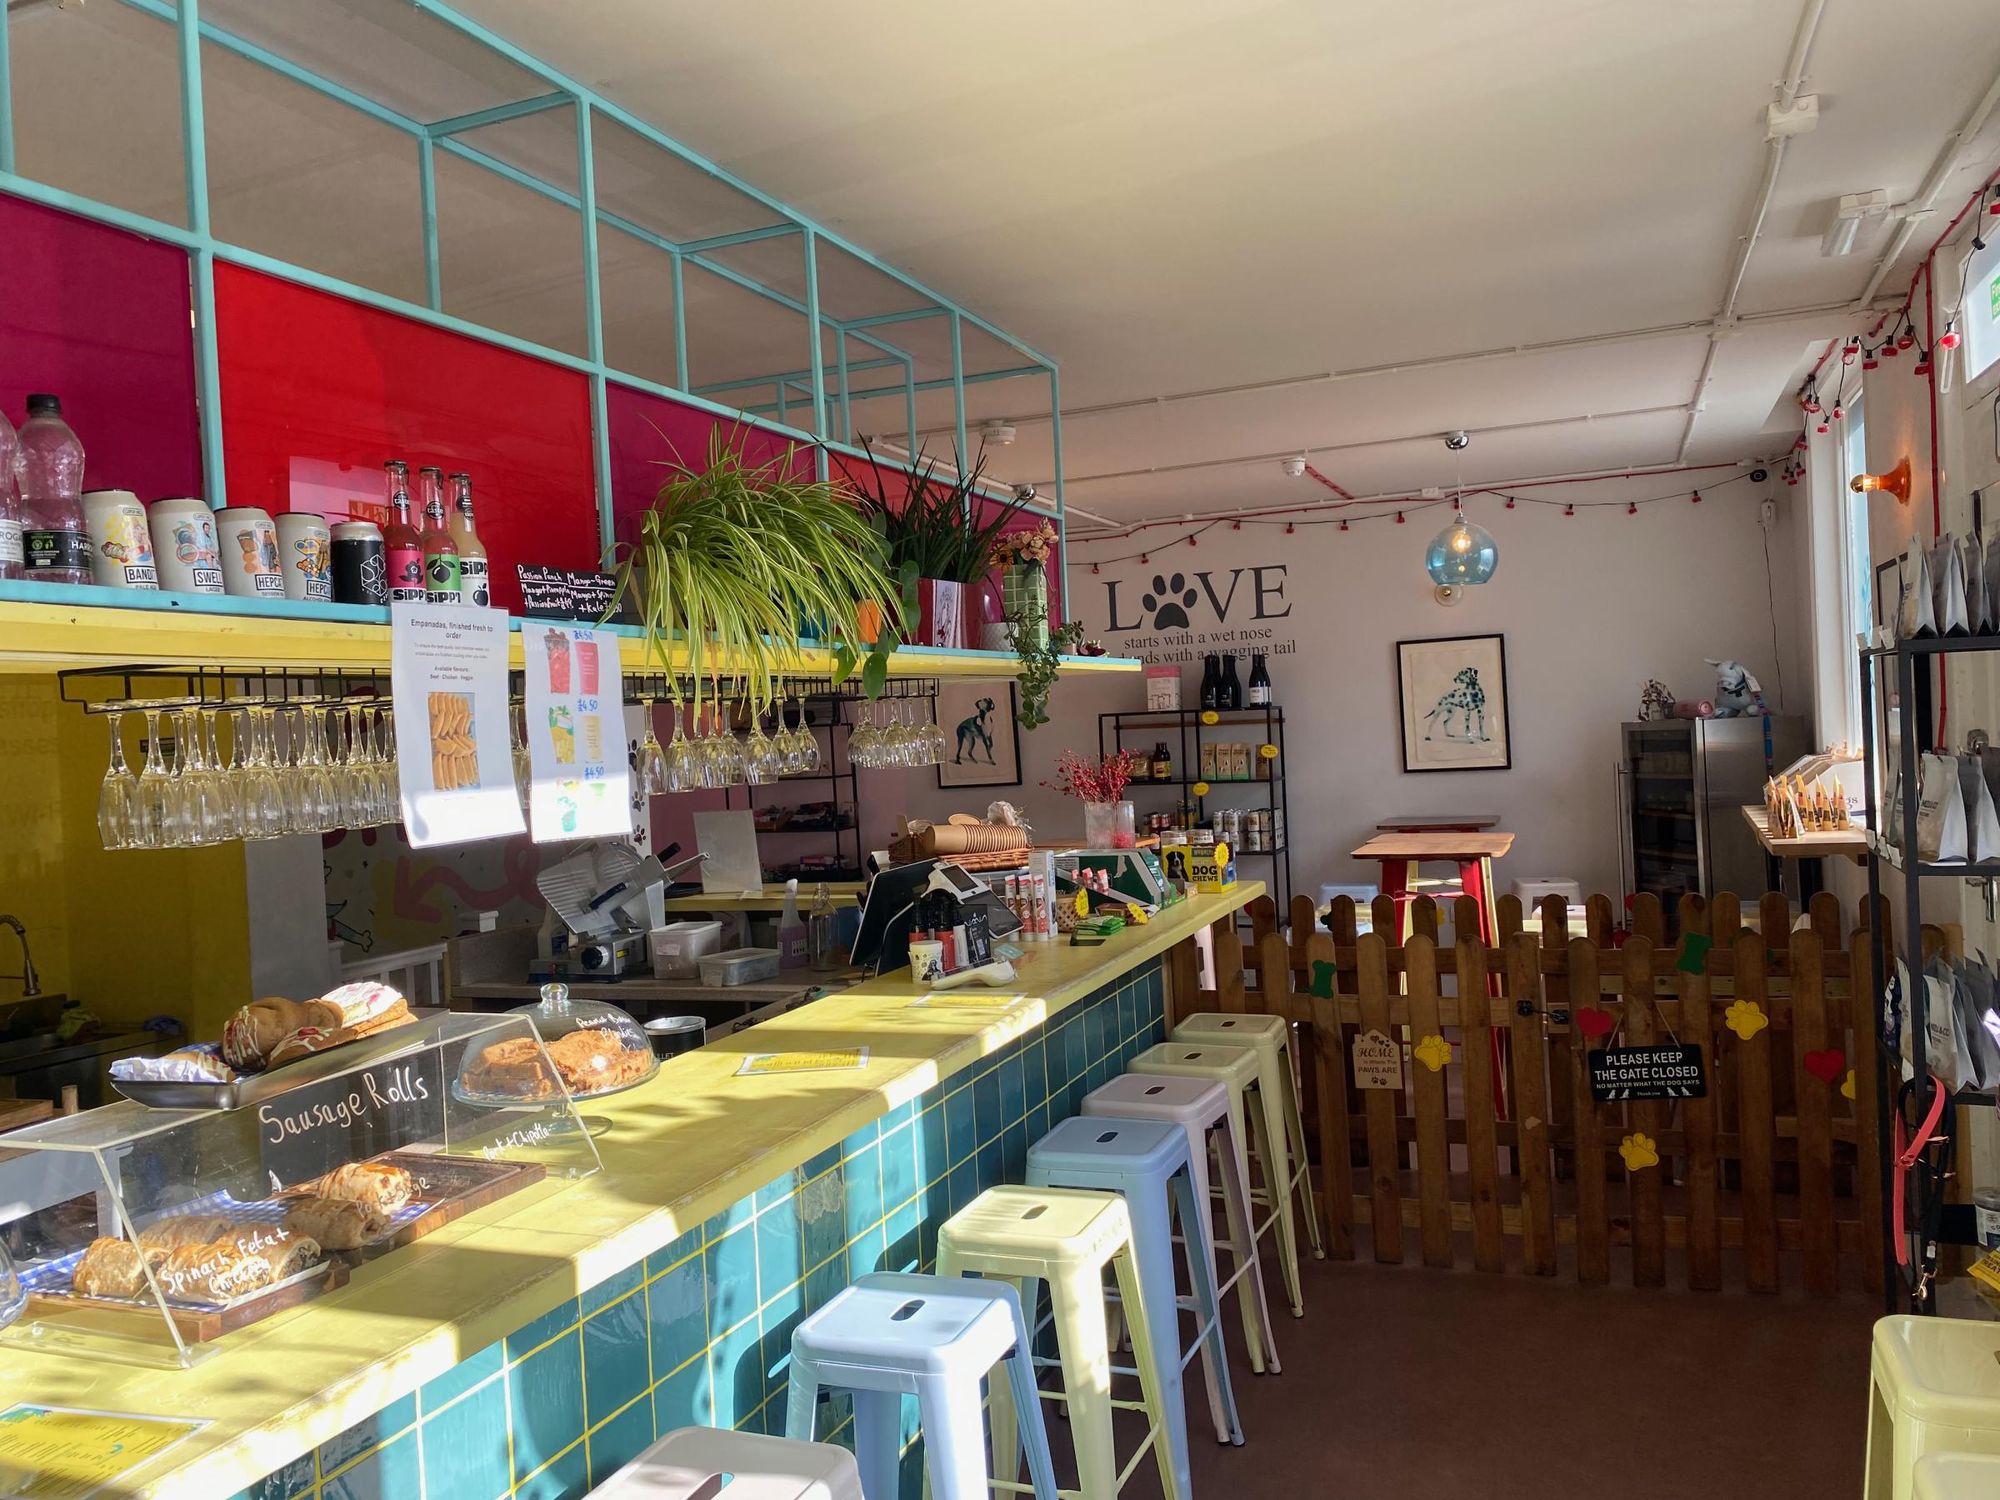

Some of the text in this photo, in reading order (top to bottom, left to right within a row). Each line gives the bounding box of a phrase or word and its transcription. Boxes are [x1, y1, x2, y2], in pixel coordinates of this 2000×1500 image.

[445, 631, 462, 639] order
[1124, 627, 1272, 649] starts with a wet nose
[1163, 647, 1194, 662] with
[1274, 640, 1297, 655] tail
[1192, 865, 1218, 876] DOG
[1606, 1052, 1683, 1066] PLEASE KEEP
[1594, 1066, 1699, 1081] THE GATE CLOSED
[258, 1065, 429, 1144] Sausage Rolls
